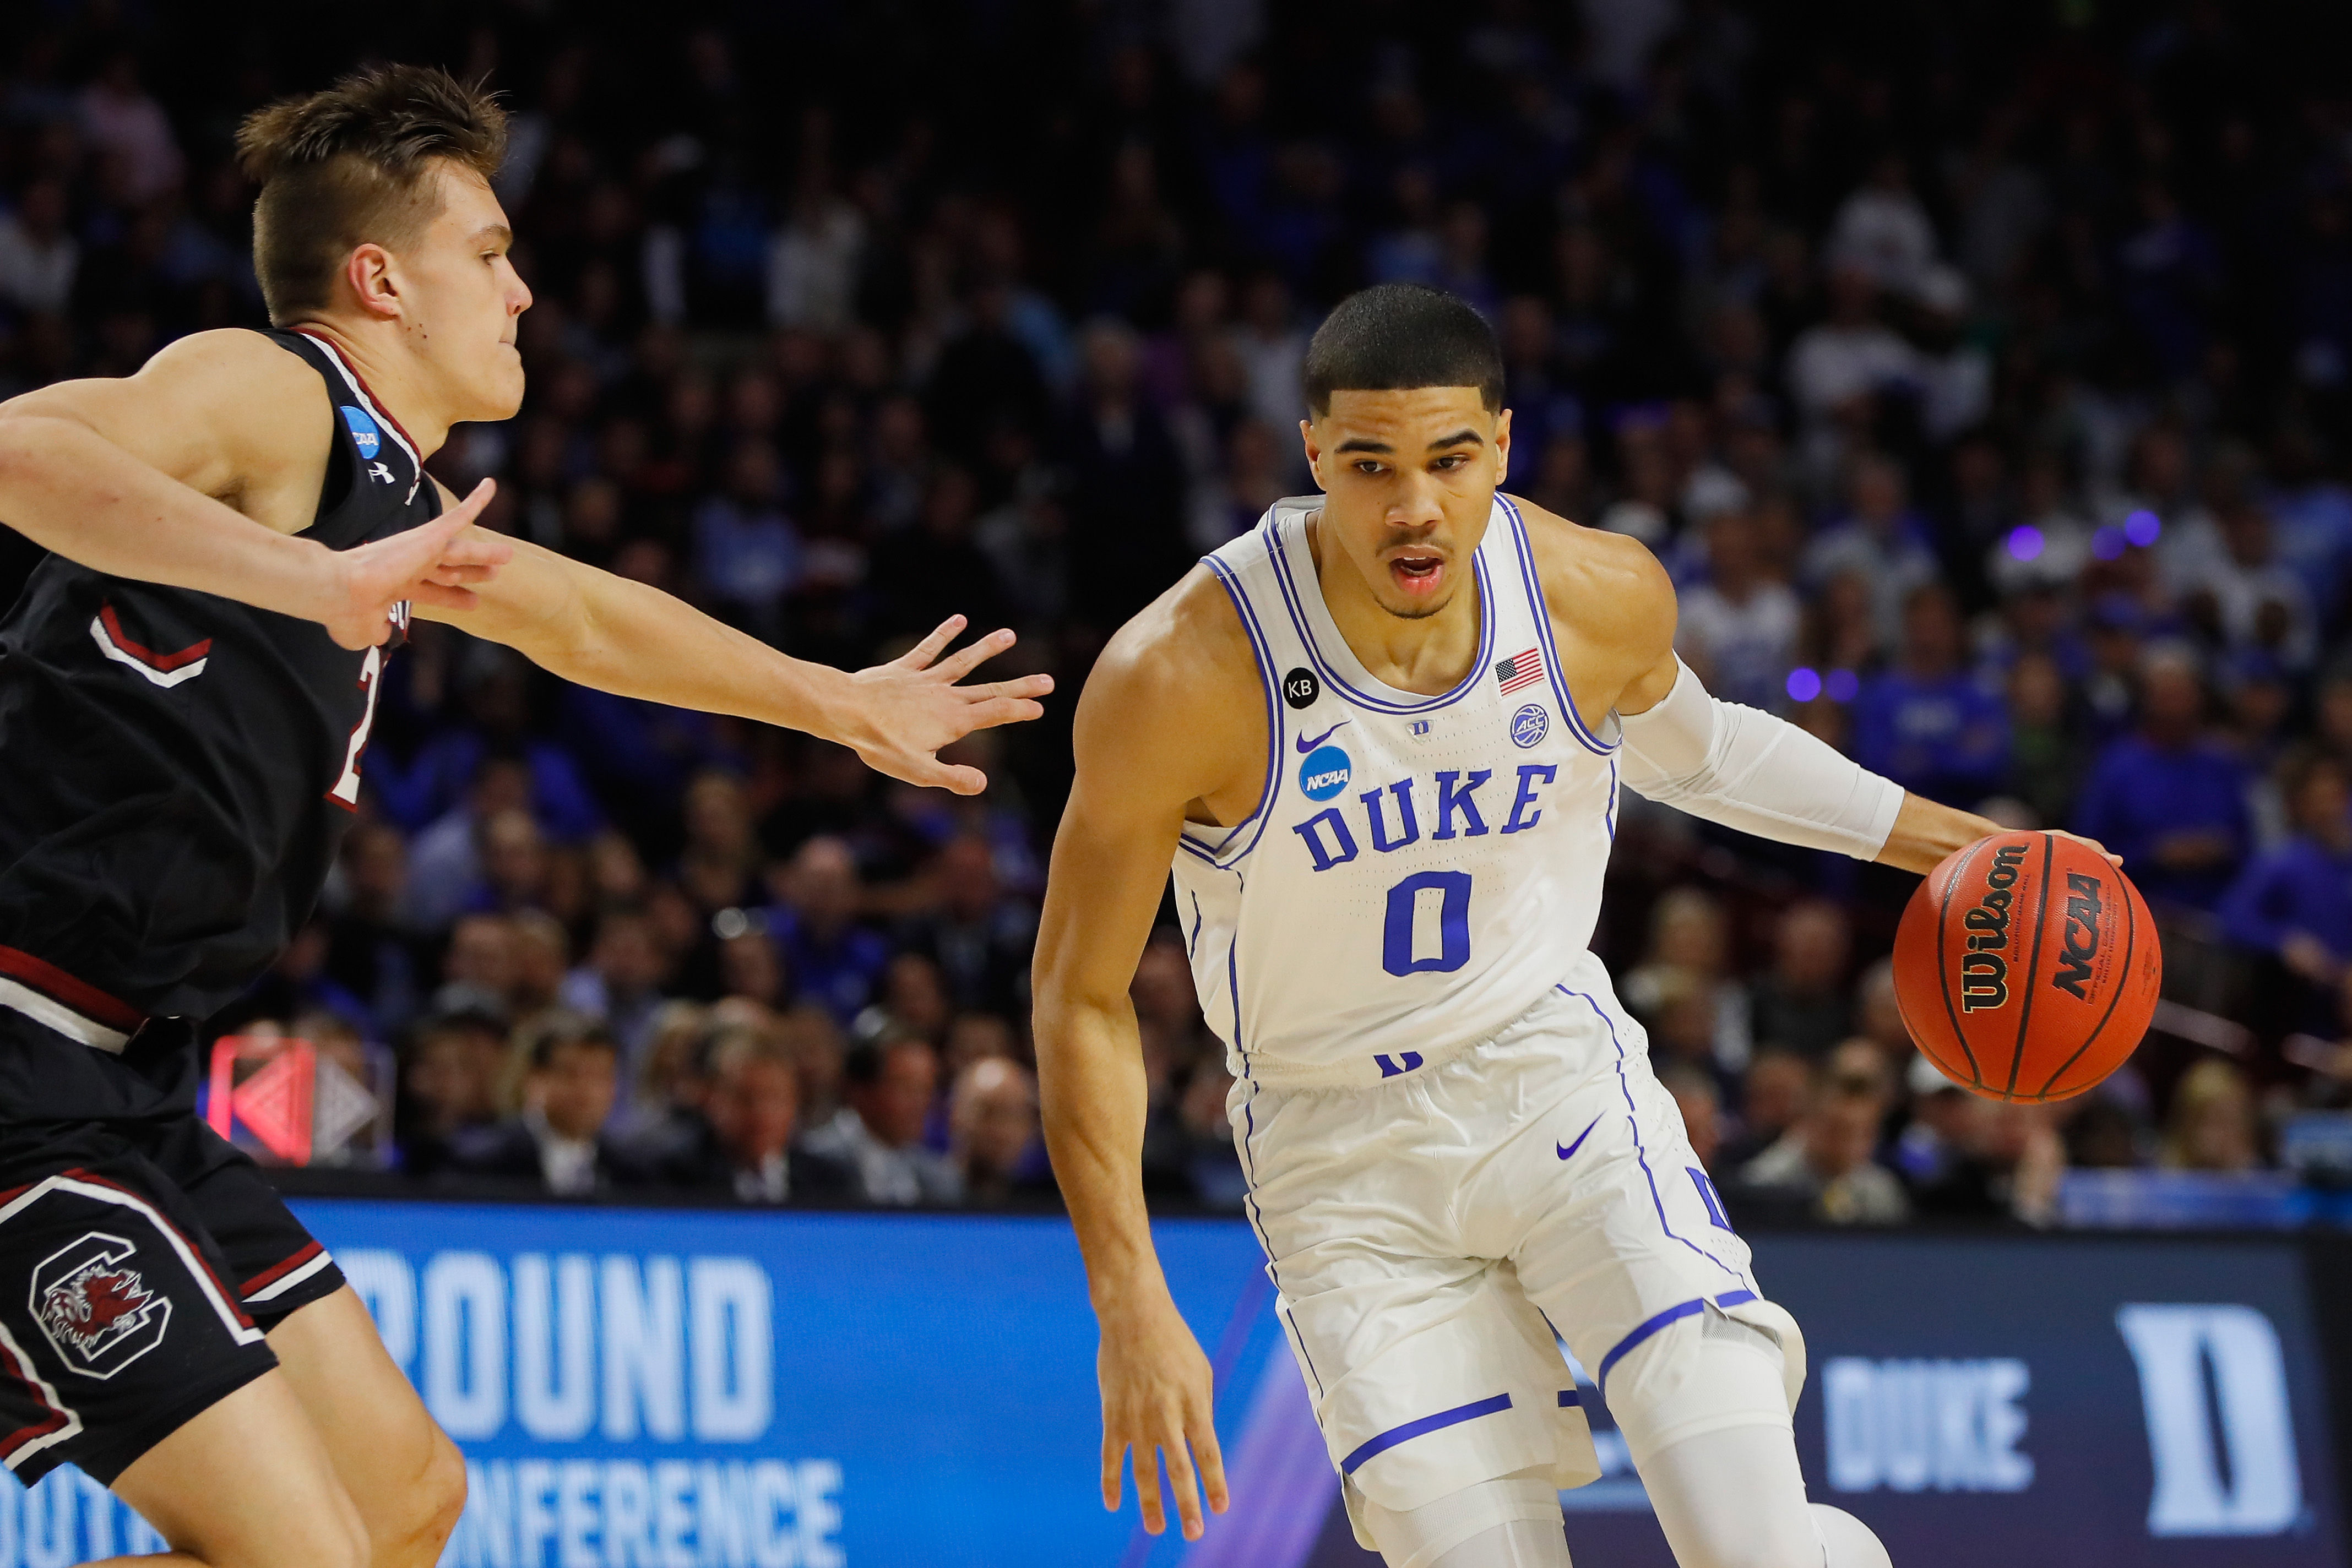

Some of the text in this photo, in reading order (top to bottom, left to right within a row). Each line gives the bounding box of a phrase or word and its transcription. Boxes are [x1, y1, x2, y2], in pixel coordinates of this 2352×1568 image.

[352, 432, 379, 446] CAA
[1288, 679, 1312, 699] KB
[1413, 721, 1429, 736] D
[1516, 715, 1545, 732] ACC
[1292, 764, 1558, 872] DUKE
[1306, 768, 1349, 792] NCAA
[1382, 870, 1472, 977] 0
[1962, 843, 2030, 1014] Wilson
[2052, 872, 2101, 1001] NCAA
[1821, 1355, 2034, 1494] DUKE
[2115, 1302, 2304, 1538] D
[435, 1458, 845, 1568] NFERENCE
